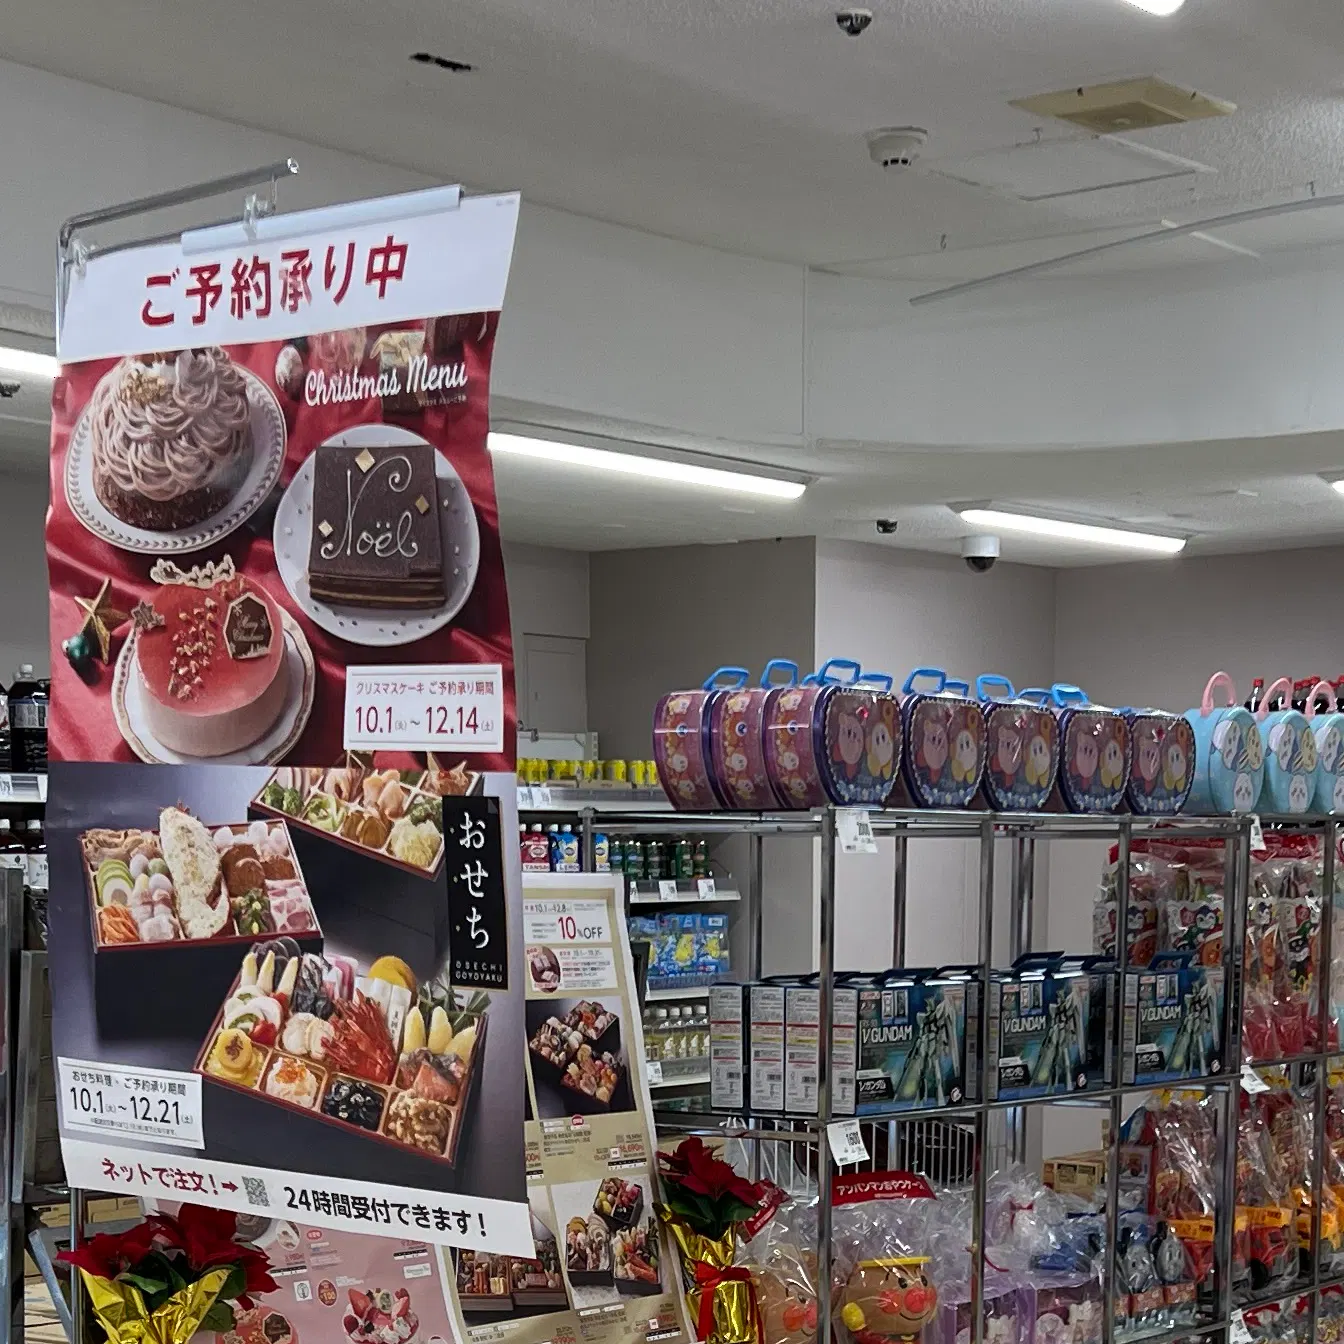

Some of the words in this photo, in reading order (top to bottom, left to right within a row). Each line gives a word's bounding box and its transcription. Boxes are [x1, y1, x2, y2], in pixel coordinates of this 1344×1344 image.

[141, 234, 410, 328] ご予約承り中
[305, 367, 401, 408] Christmas
[406, 354, 468, 394] Menu
[320, 456, 418, 560] Noël
[356, 680, 425, 695] クリスマスケーキ
[428, 680, 494, 696] ご予約承り期間
[459, 811, 490, 949] おせち
